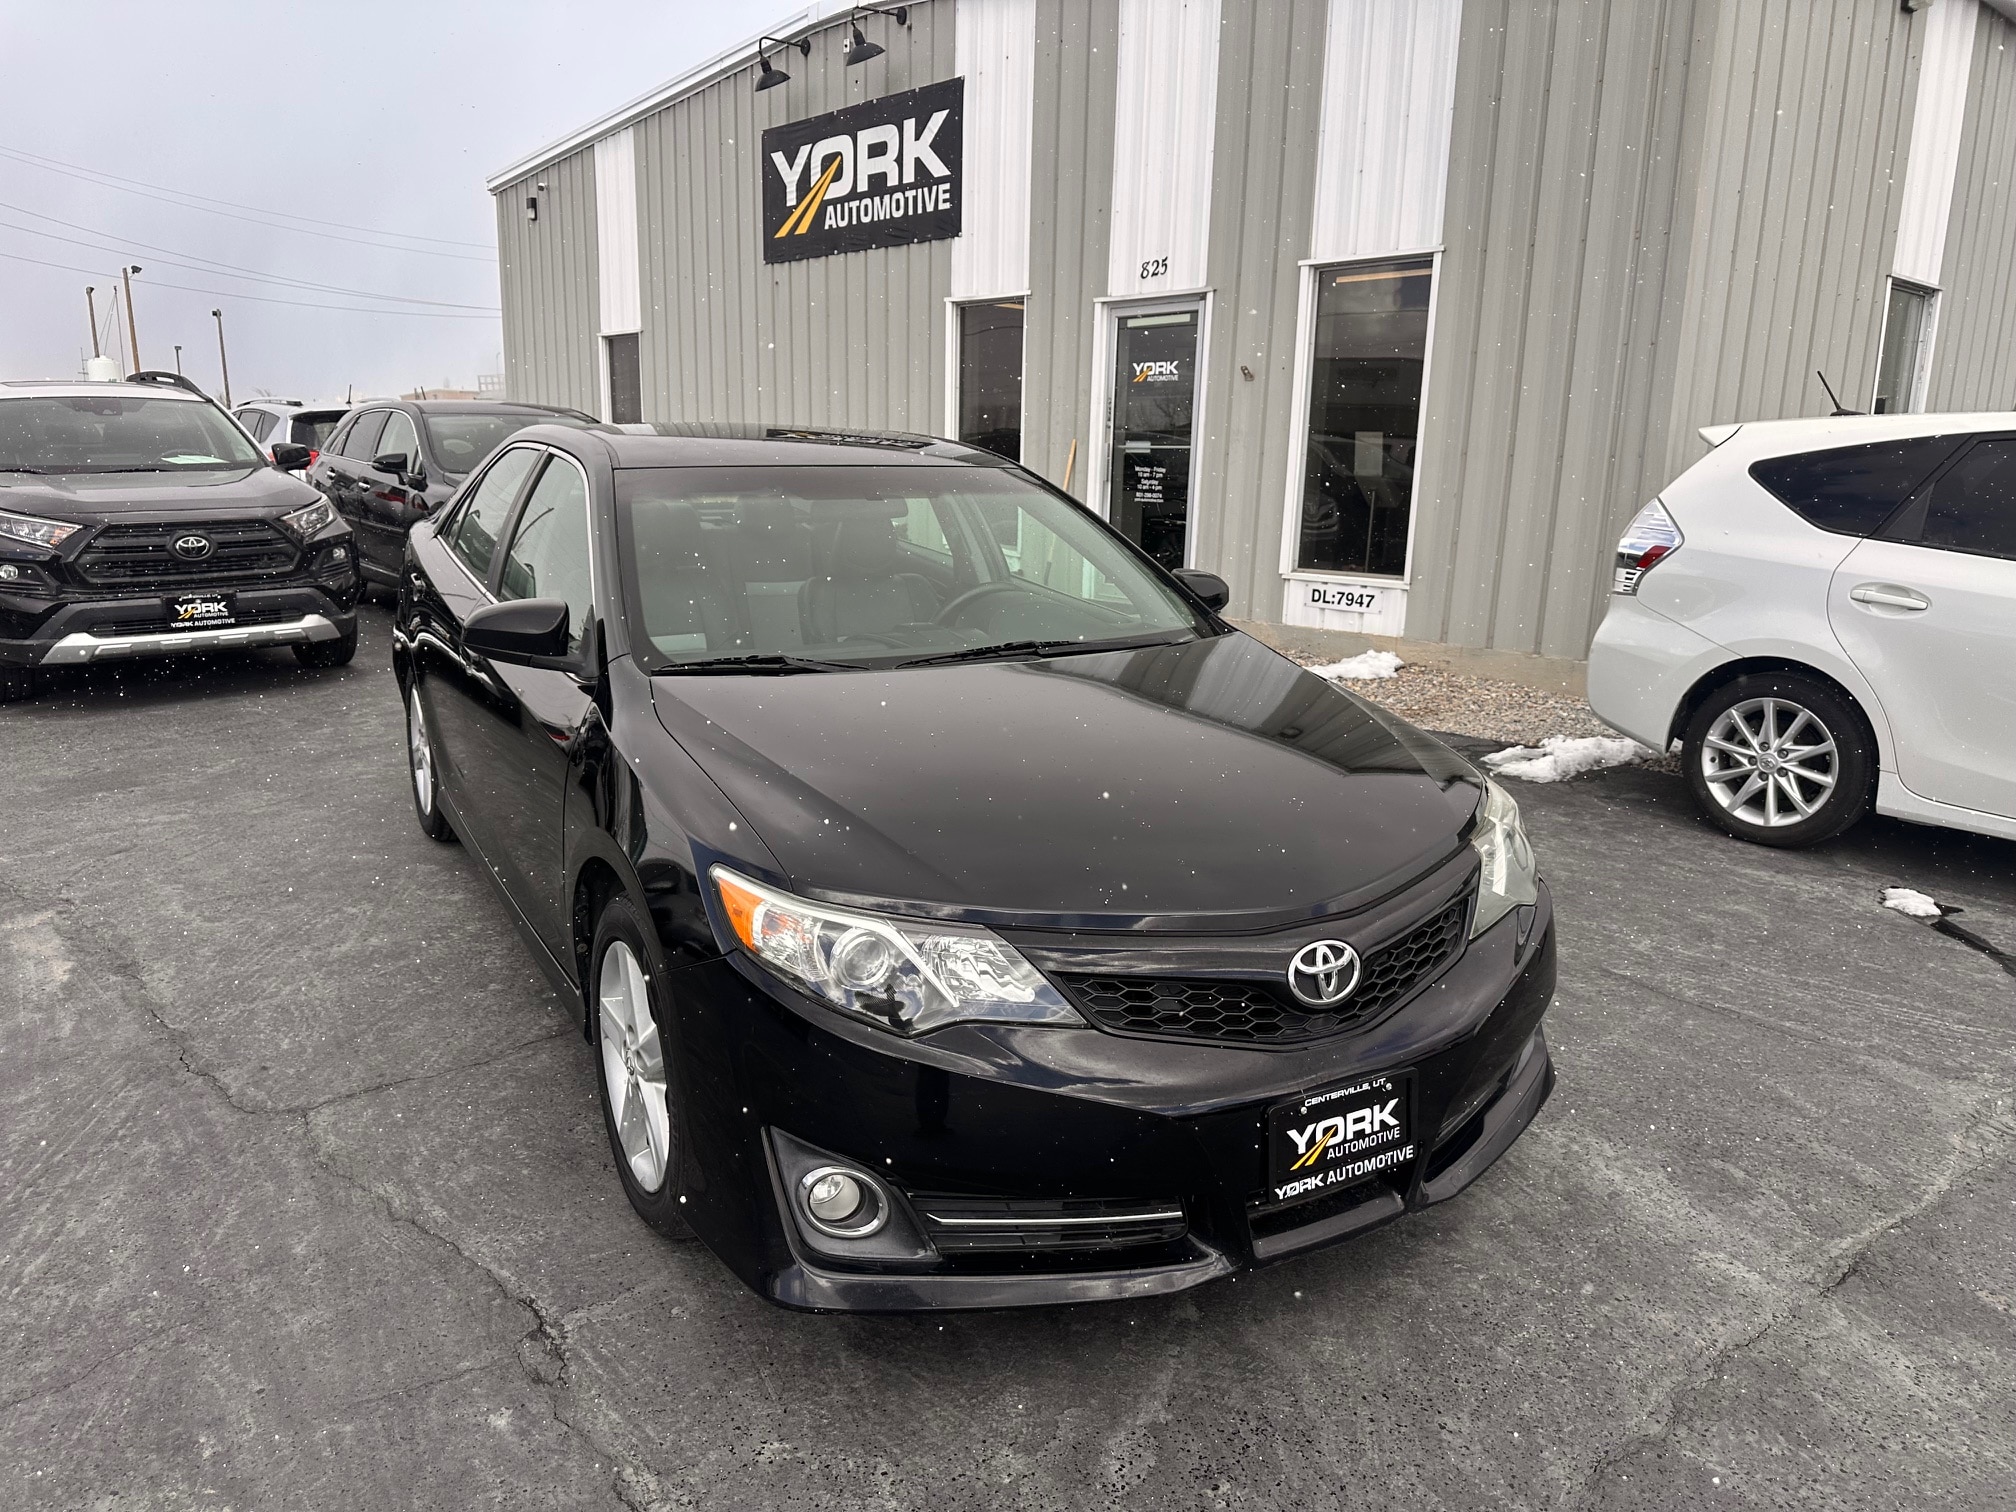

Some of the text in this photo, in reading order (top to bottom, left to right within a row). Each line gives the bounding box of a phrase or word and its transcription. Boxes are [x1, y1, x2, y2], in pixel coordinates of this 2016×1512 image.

[770, 109, 951, 207] YORK
[824, 183, 951, 230] AUTOMOTIVE
[1140, 256, 1168, 279] 825
[1132, 360, 1179, 375] YORK
[174, 602, 228, 614] YORK
[1311, 588, 1375, 608] DL:7947
[194, 618, 235, 627] AUTOMOTIVE
[1304, 1077, 1386, 1107] CENTERVILLE, UT
[1286, 1098, 1400, 1155] YORK
[1326, 1126, 1401, 1160] AUTOMOTIVE
[1274, 1145, 1414, 1200] YORK AUTOMOTIVE
